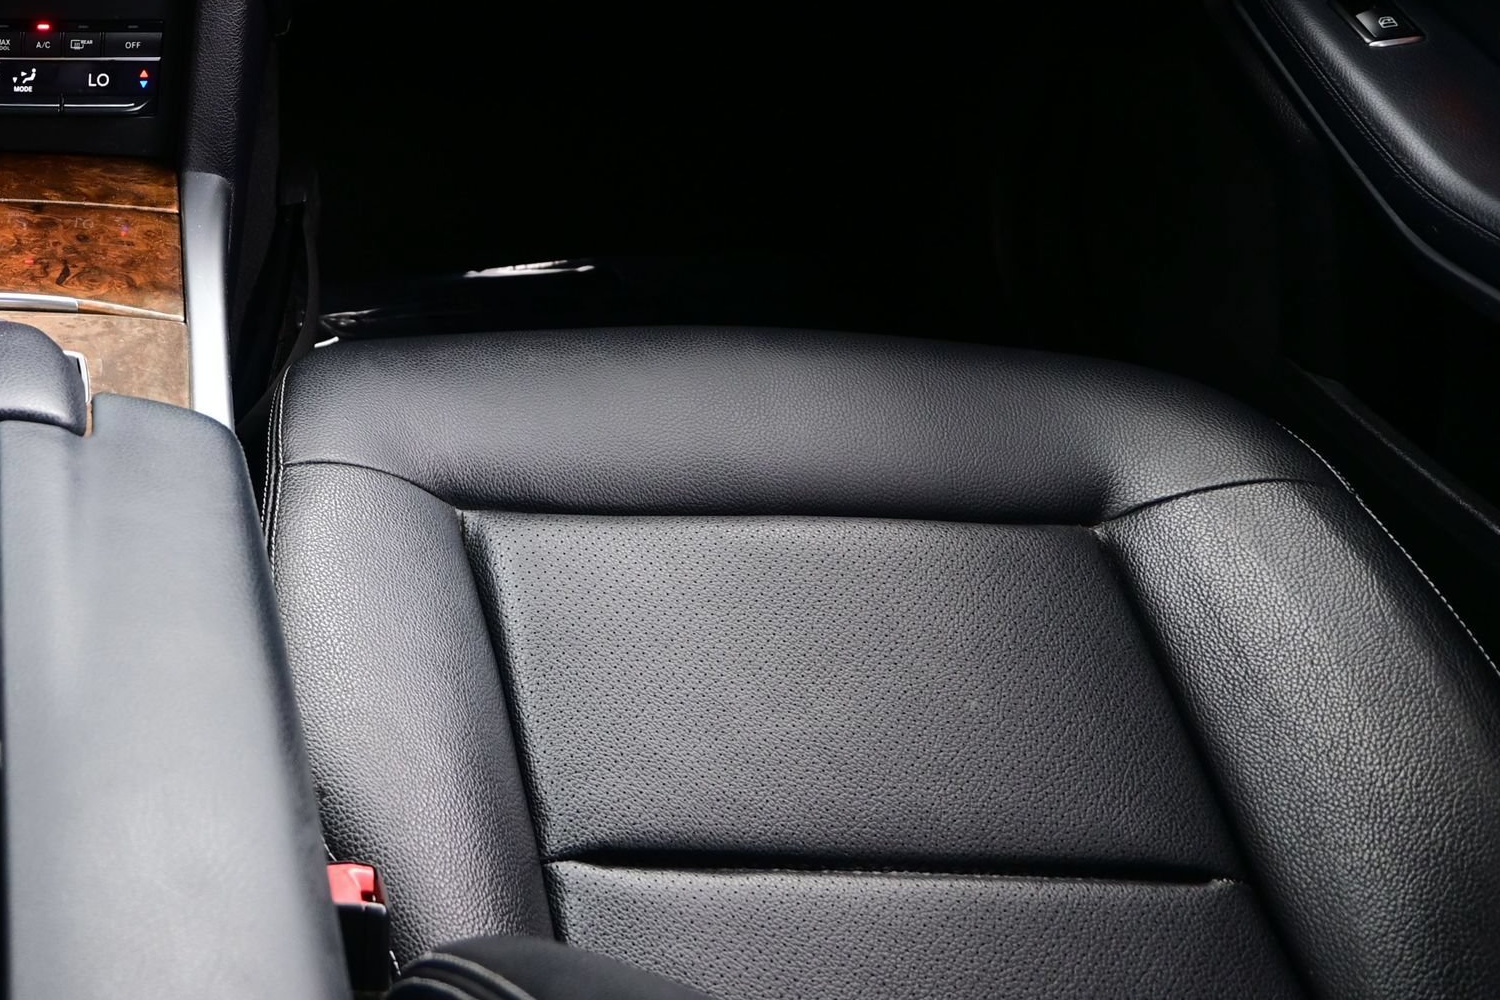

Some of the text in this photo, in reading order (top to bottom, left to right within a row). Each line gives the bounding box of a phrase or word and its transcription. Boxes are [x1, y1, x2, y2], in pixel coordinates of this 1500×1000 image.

[35, 41, 51, 49] A/C
[125, 41, 141, 49] OFF
[88, 73, 110, 87] LO
[13, 85, 33, 93] MODE
